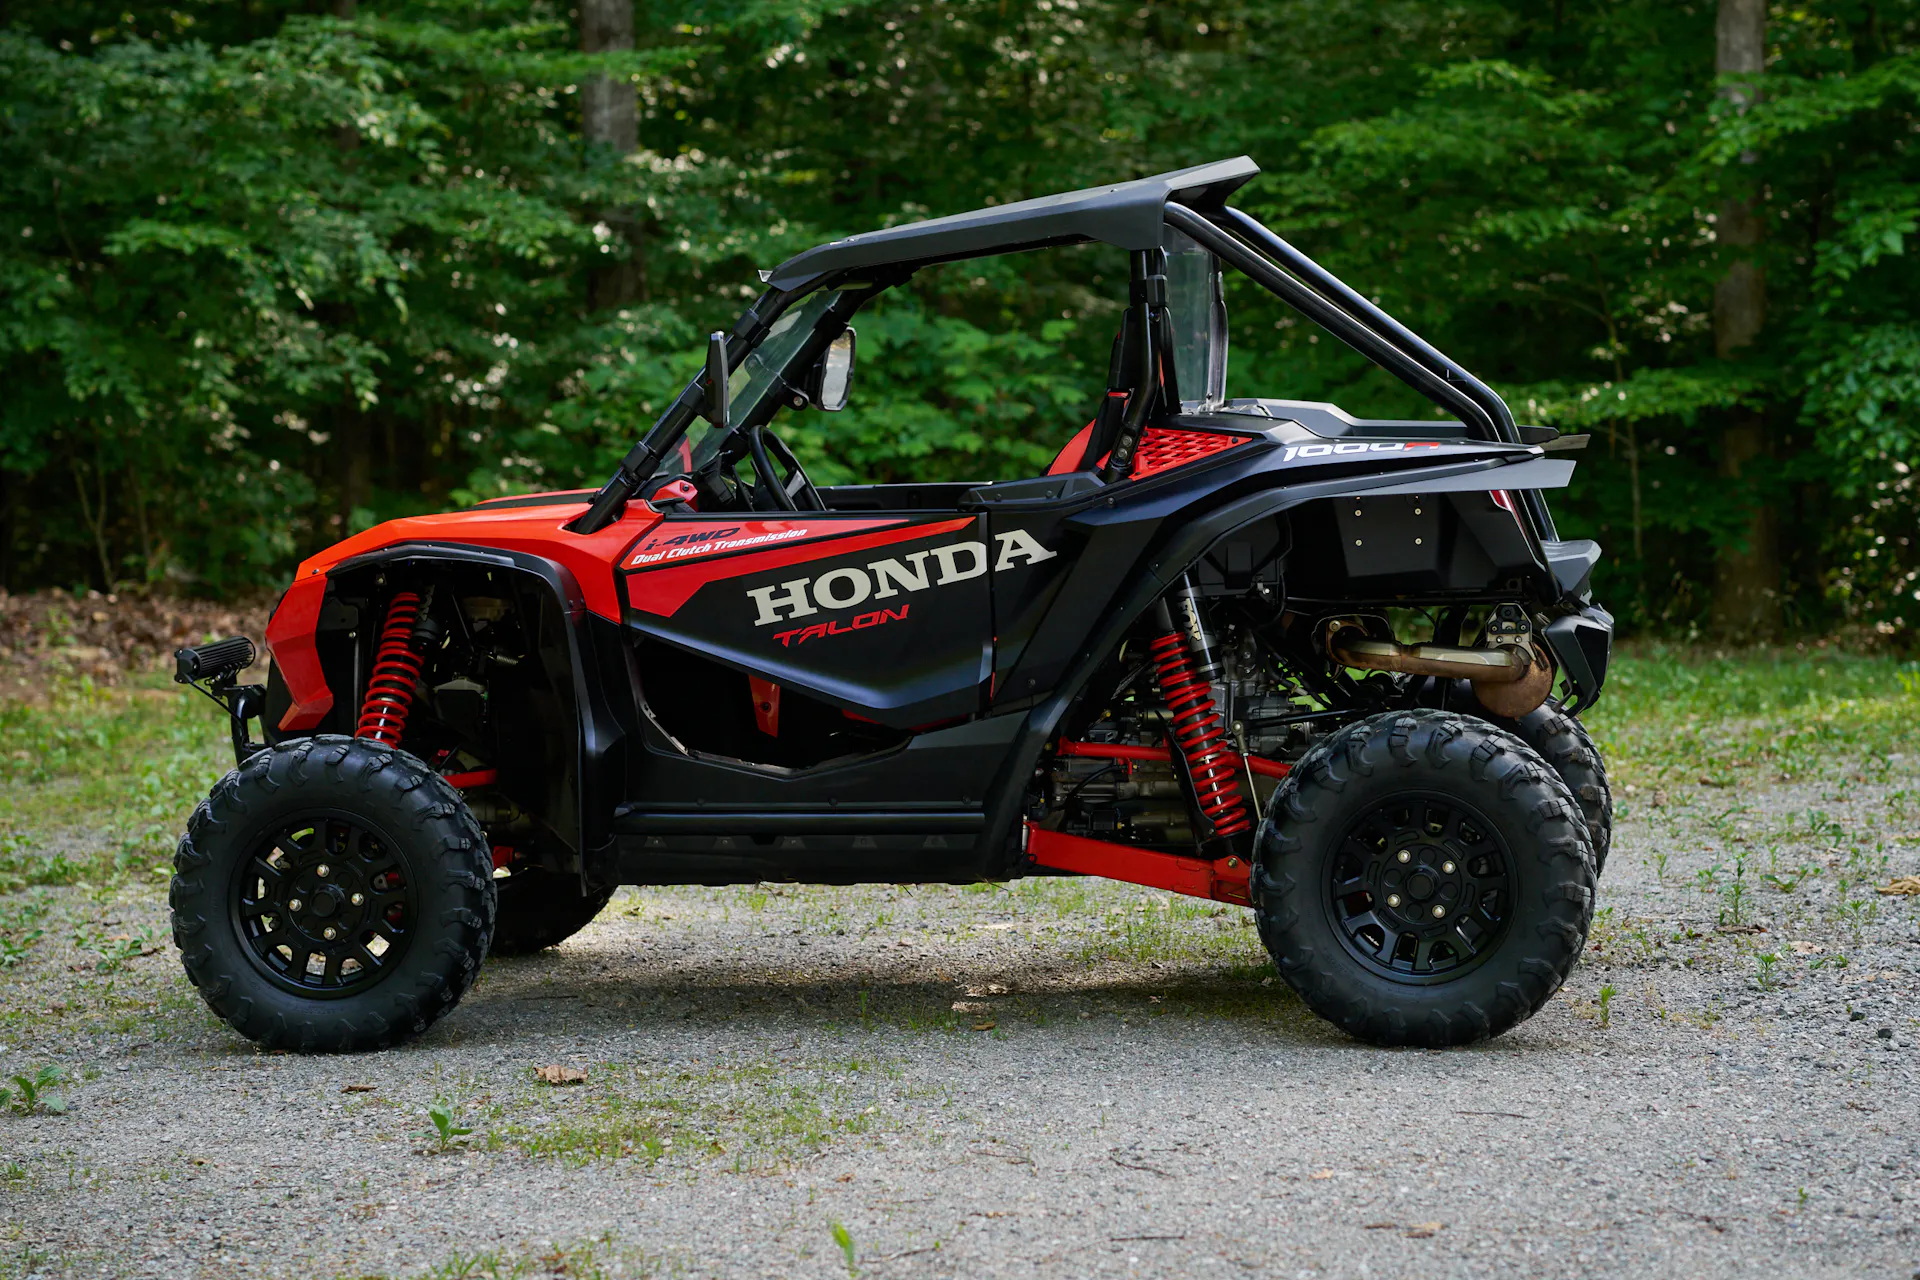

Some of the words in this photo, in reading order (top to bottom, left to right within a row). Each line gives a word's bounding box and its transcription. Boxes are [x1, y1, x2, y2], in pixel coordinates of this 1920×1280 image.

[631, 549, 667, 565] Dual
[666, 541, 712, 559] Clutch
[713, 528, 807, 550] Transmission
[746, 529, 1057, 627] HONDA
[773, 604, 910, 648] TALON
[1178, 597, 1202, 642] FOX
